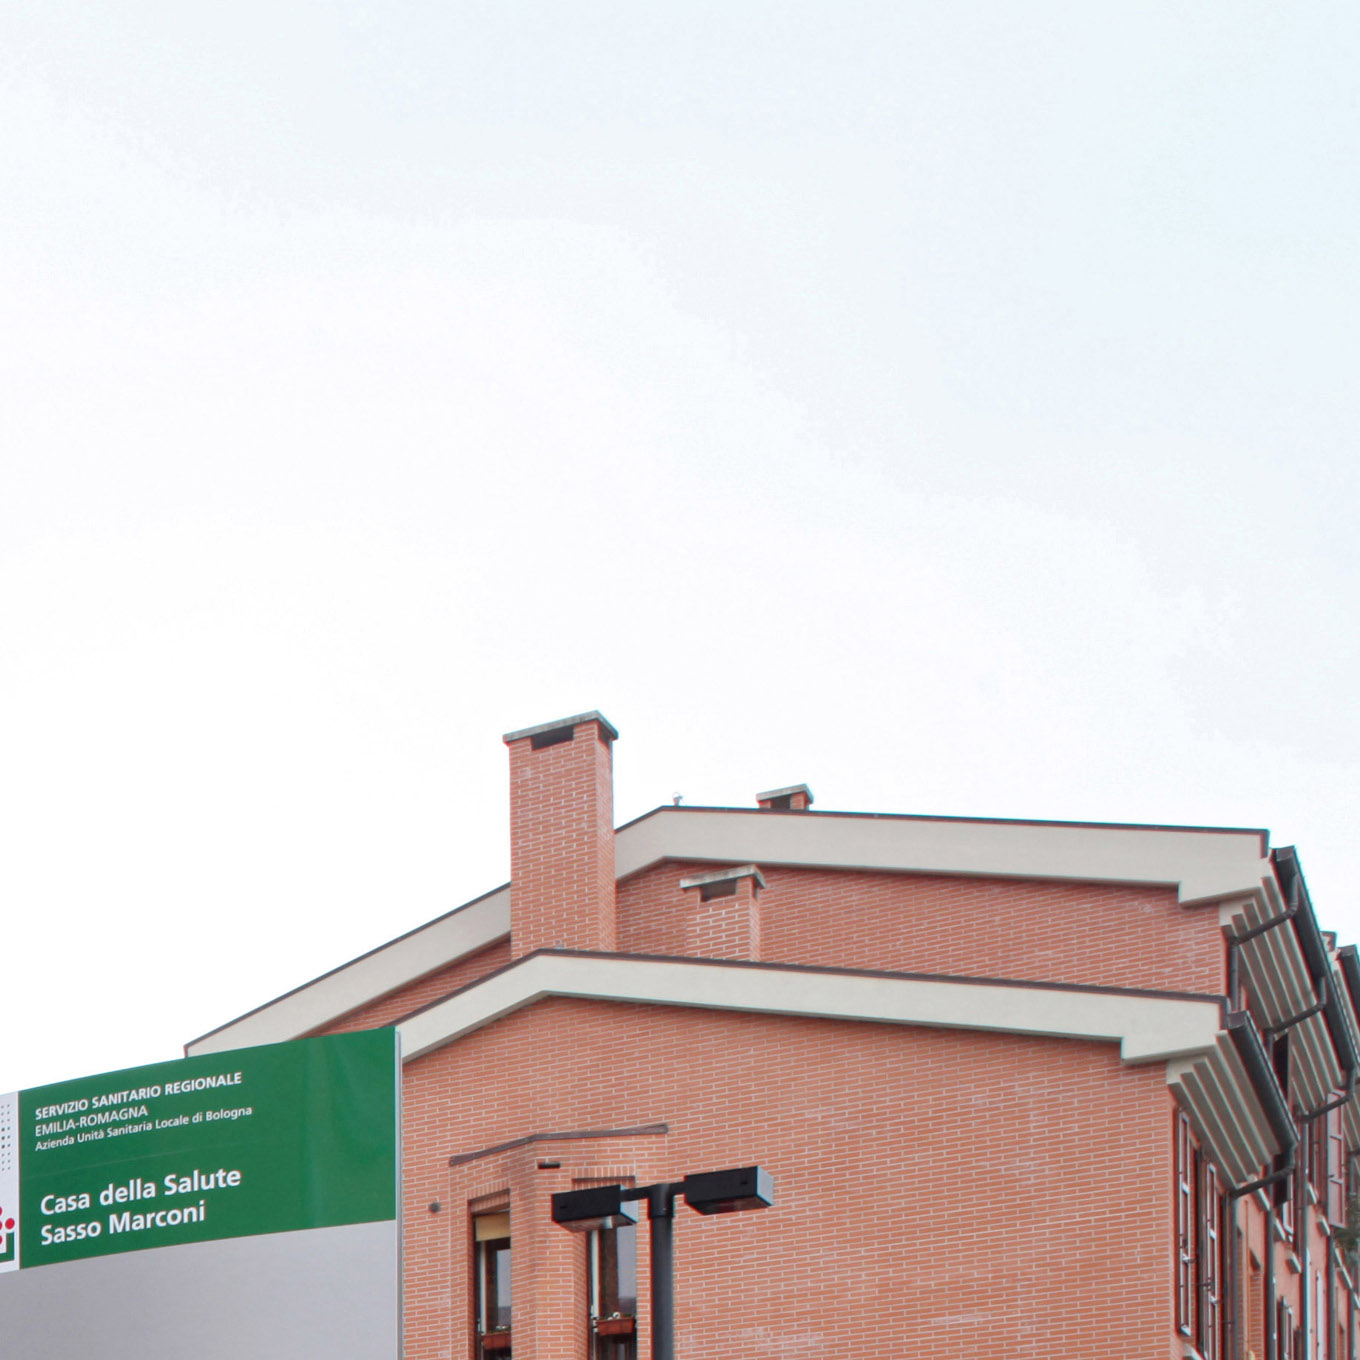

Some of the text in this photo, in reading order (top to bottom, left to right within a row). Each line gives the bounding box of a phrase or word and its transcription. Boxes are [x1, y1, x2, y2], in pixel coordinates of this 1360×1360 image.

[35, 1072, 242, 1120] SERVIZIO SANITARIO REGIONALE
[35, 1105, 148, 1137] EMILIA-ROMAGNA
[35, 1106, 252, 1151] Azienda Unità Sanitaria Locale di Bologna
[40, 1168, 241, 1216] Casa della Salute
[41, 1199, 206, 1246] Sasso Marconi
